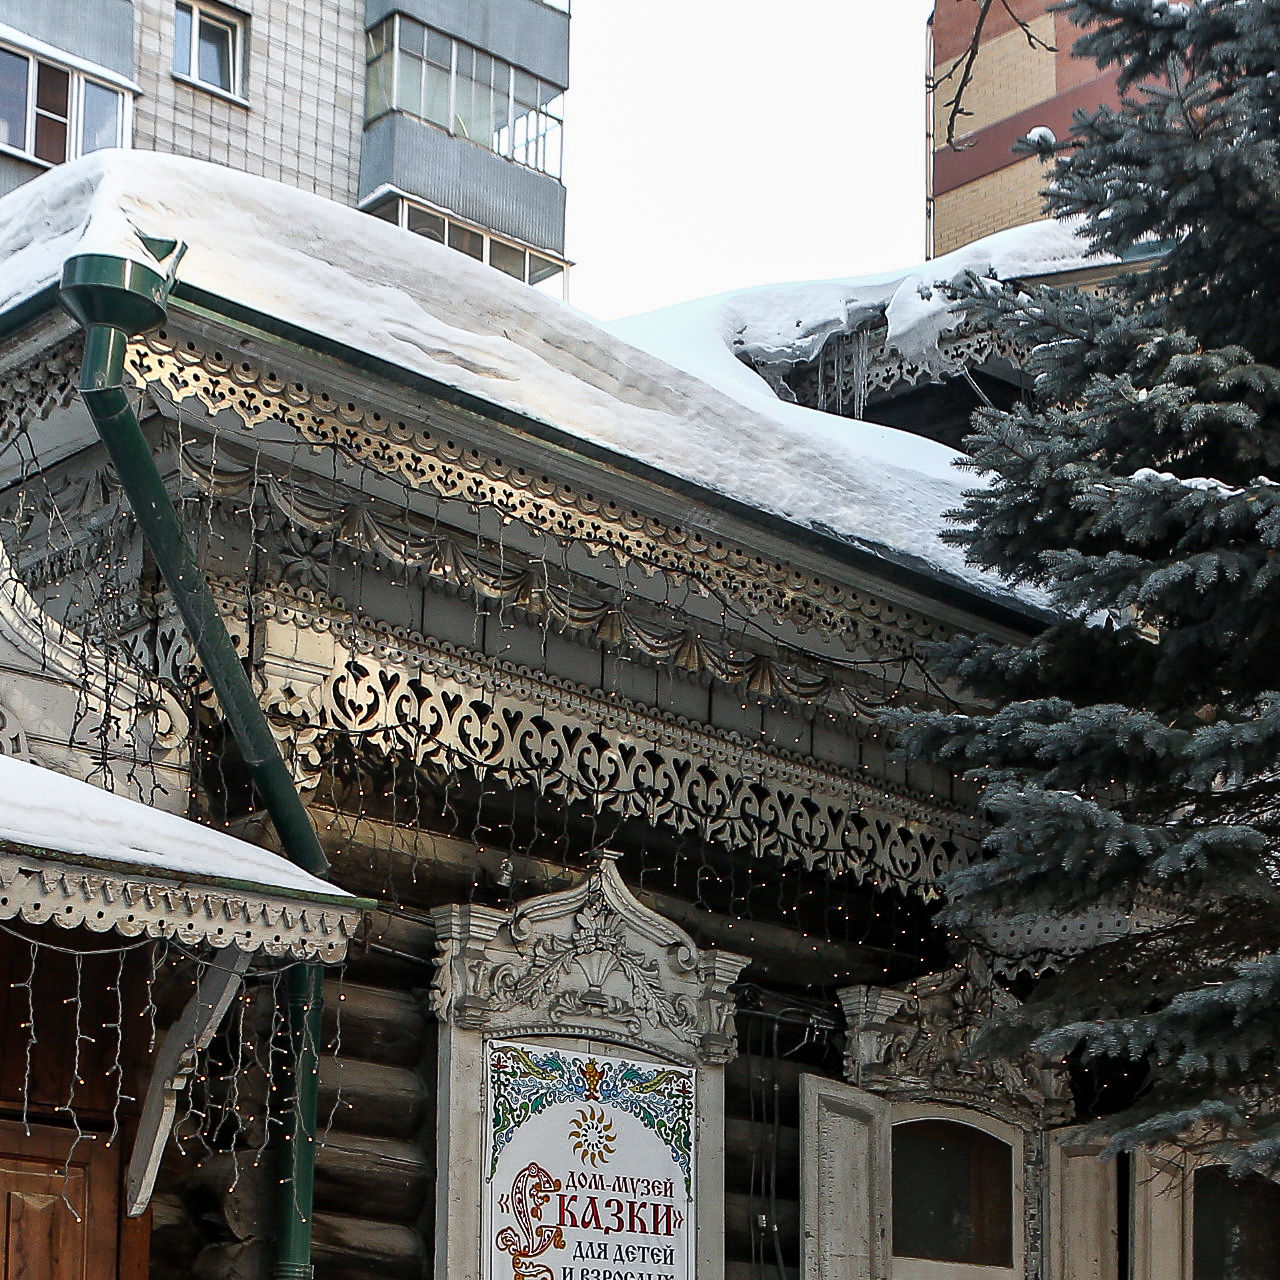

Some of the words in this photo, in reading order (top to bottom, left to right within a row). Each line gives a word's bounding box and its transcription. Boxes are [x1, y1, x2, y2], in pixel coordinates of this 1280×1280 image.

[565, 1171, 674, 1199] ДОМ-МУЗЕЙ
[572, 1240, 609, 1262] ДЛЯ
[612, 1244, 675, 1266] ДЕТЕЙ
